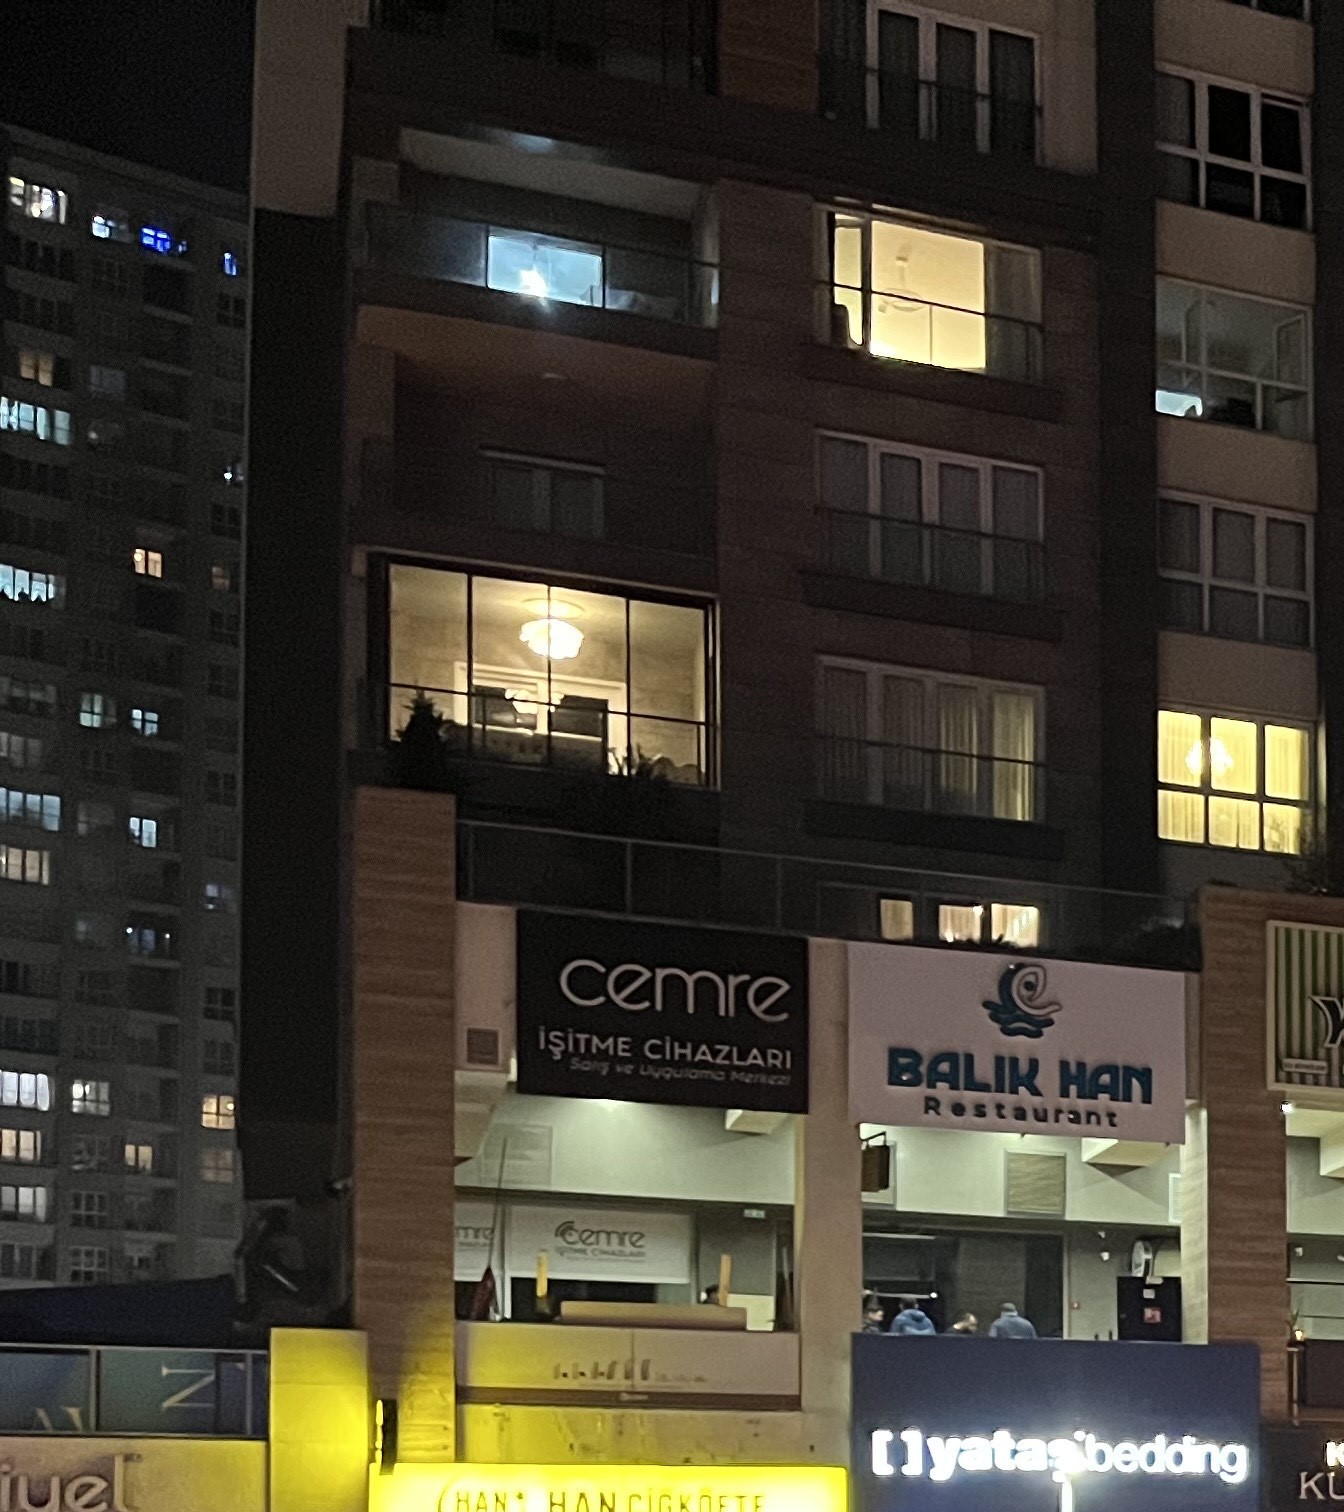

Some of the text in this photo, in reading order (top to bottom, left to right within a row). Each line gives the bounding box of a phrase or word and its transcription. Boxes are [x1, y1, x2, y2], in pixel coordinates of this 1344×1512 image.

[559, 958, 791, 1022] cemre
[538, 1024, 792, 1070] İŞİTME CİHAZLARI
[616, 1062, 633, 1076] ve
[887, 1046, 1153, 1105] BALIK HAN
[923, 1096, 1118, 1128] Restaurant
[1082, 1433, 1251, 1486] bedding
